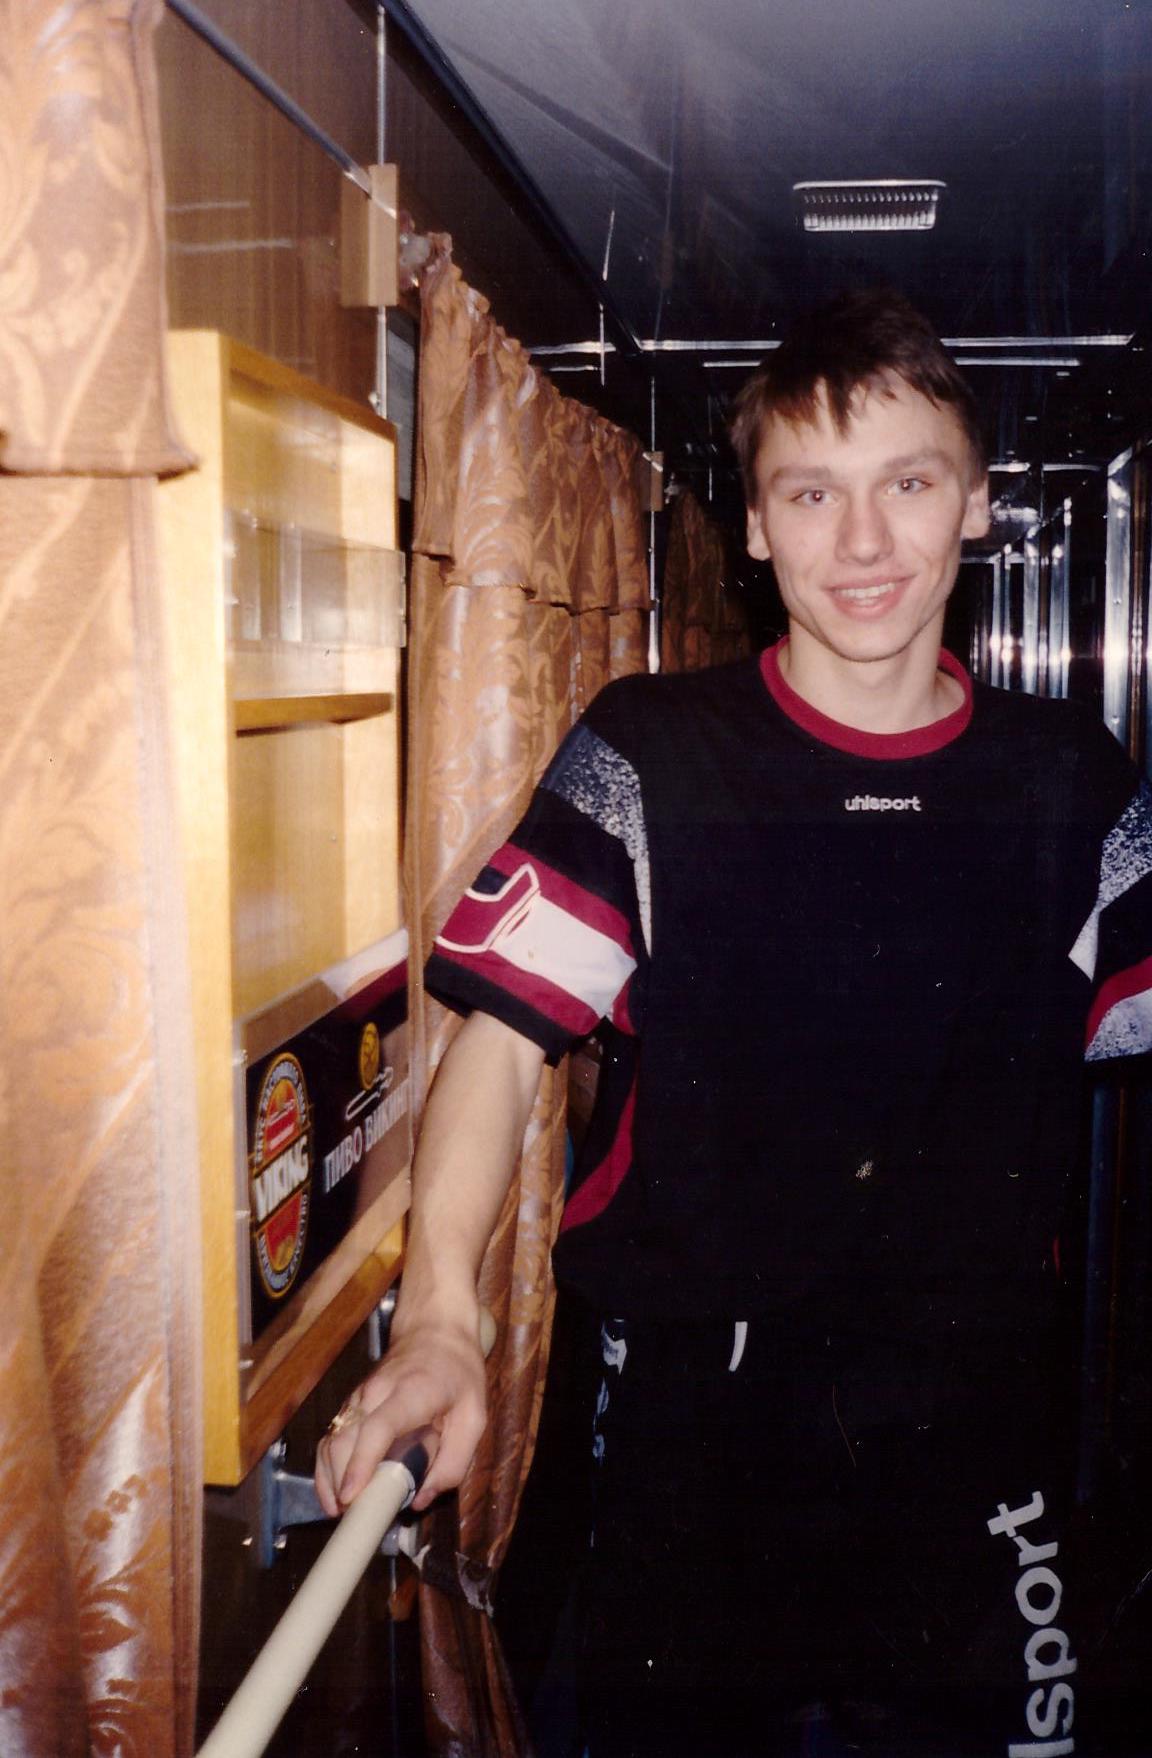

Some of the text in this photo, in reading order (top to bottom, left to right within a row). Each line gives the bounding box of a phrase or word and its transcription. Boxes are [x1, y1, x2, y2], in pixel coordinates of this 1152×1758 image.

[844, 794, 922, 812] uhlsport
[254, 1134, 310, 1223] VIKING
[323, 1126, 363, 1193] ПИВО
